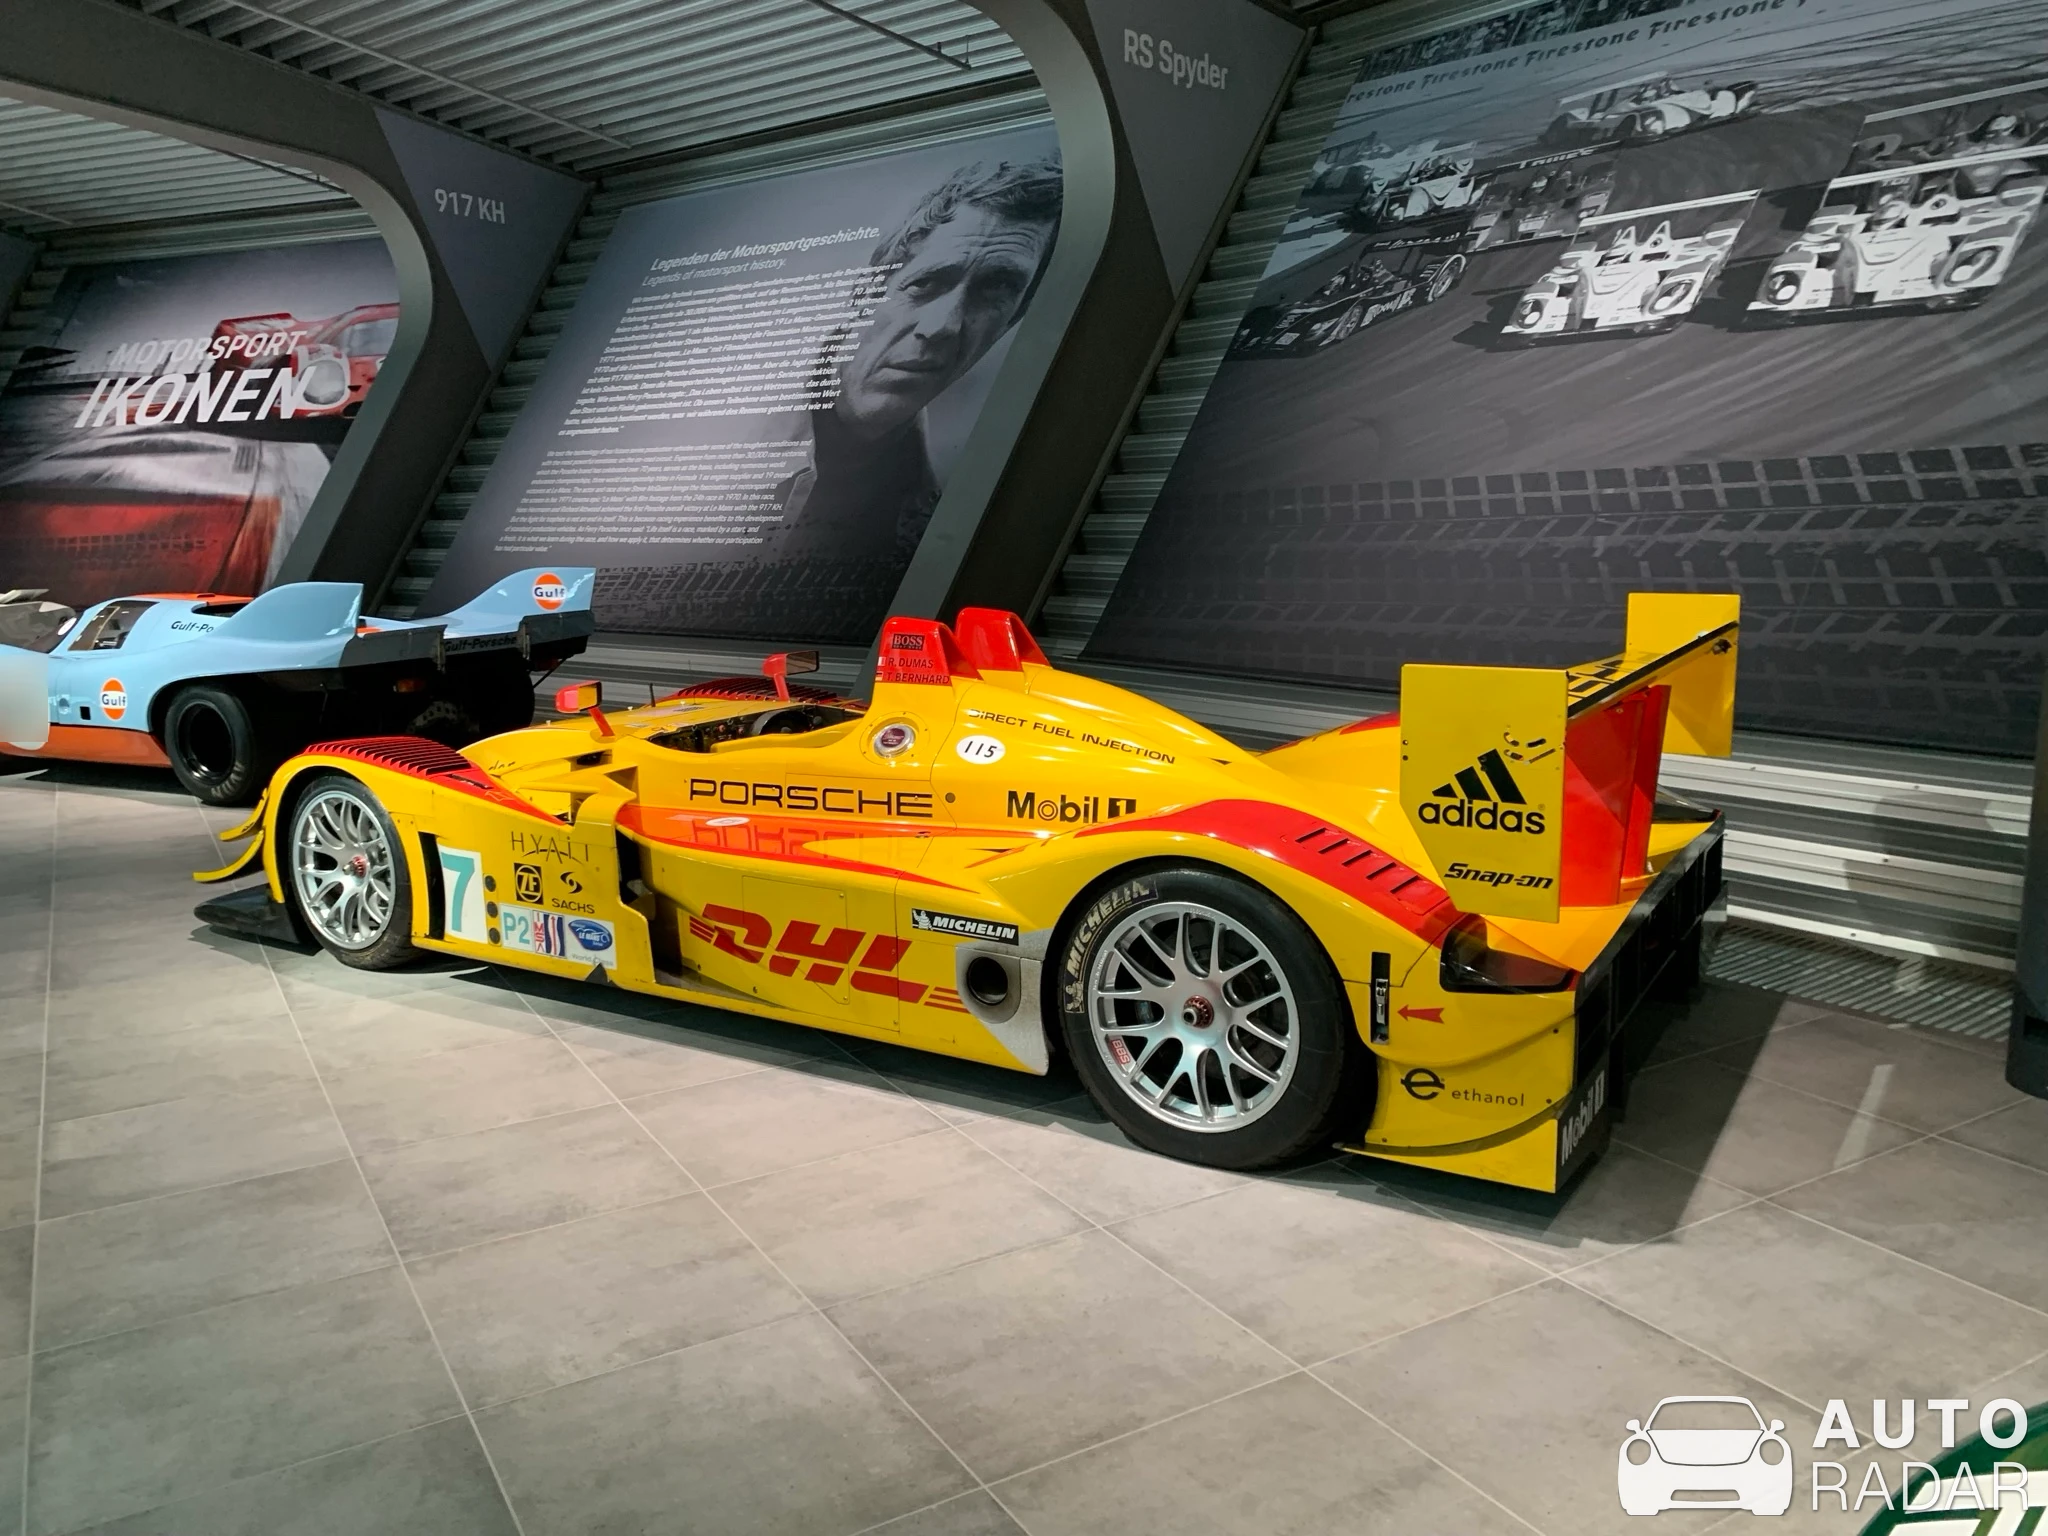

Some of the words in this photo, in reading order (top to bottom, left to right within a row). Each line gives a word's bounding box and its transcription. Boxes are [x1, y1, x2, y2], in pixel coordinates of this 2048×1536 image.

[1124, 28, 1154, 69] RS
[1159, 39, 1229, 90] Spyder
[1420, 55, 1518, 90] Firestone
[1523, 28, 1639, 68] Firestone
[435, 188, 473, 217] 917
[478, 196, 505, 224] KH
[650, 249, 710, 272] Legenden
[710, 246, 736, 262] der
[730, 225, 881, 259] Motorsportgeschichte.
[642, 270, 683, 287] Legends
[682, 268, 695, 281] of
[693, 262, 750, 279] motorsport
[750, 257, 787, 272] history.
[110, 331, 307, 366] MOTORSPORT
[74, 366, 317, 428] IKONEN
[534, 587, 565, 598] Gulf
[445, 635, 517, 652] Gulf-Porsche
[894, 636, 923, 647] BOSS
[886, 671, 894, 681] T.
[895, 673, 951, 685] BERNHARD
[888, 657, 896, 667] R.
[898, 659, 934, 669] DUMAS
[101, 693, 127, 706] Gulf
[964, 740, 998, 758] 115
[968, 709, 1027, 728] DIRECT
[1032, 722, 1075, 739] FUEL
[1081, 733, 1176, 764] INJECTION
[690, 778, 933, 818] PORSCHE
[1007, 790, 1099, 823] Mobil
[1418, 799, 1545, 834] adidas
[441, 852, 475, 932] 7
[1444, 863, 1553, 889] Snap-on
[551, 897, 596, 914] SACHS
[503, 912, 530, 945] P2
[932, 916, 1016, 939] MICHELIN
[1066, 880, 1150, 978] MICHELIN
[702, 903, 929, 1004] DHL
[1112, 1038, 1132, 1065] BBS
[1451, 1088, 1525, 1107] ethanol
[1561, 1084, 1594, 1166] Mobil
